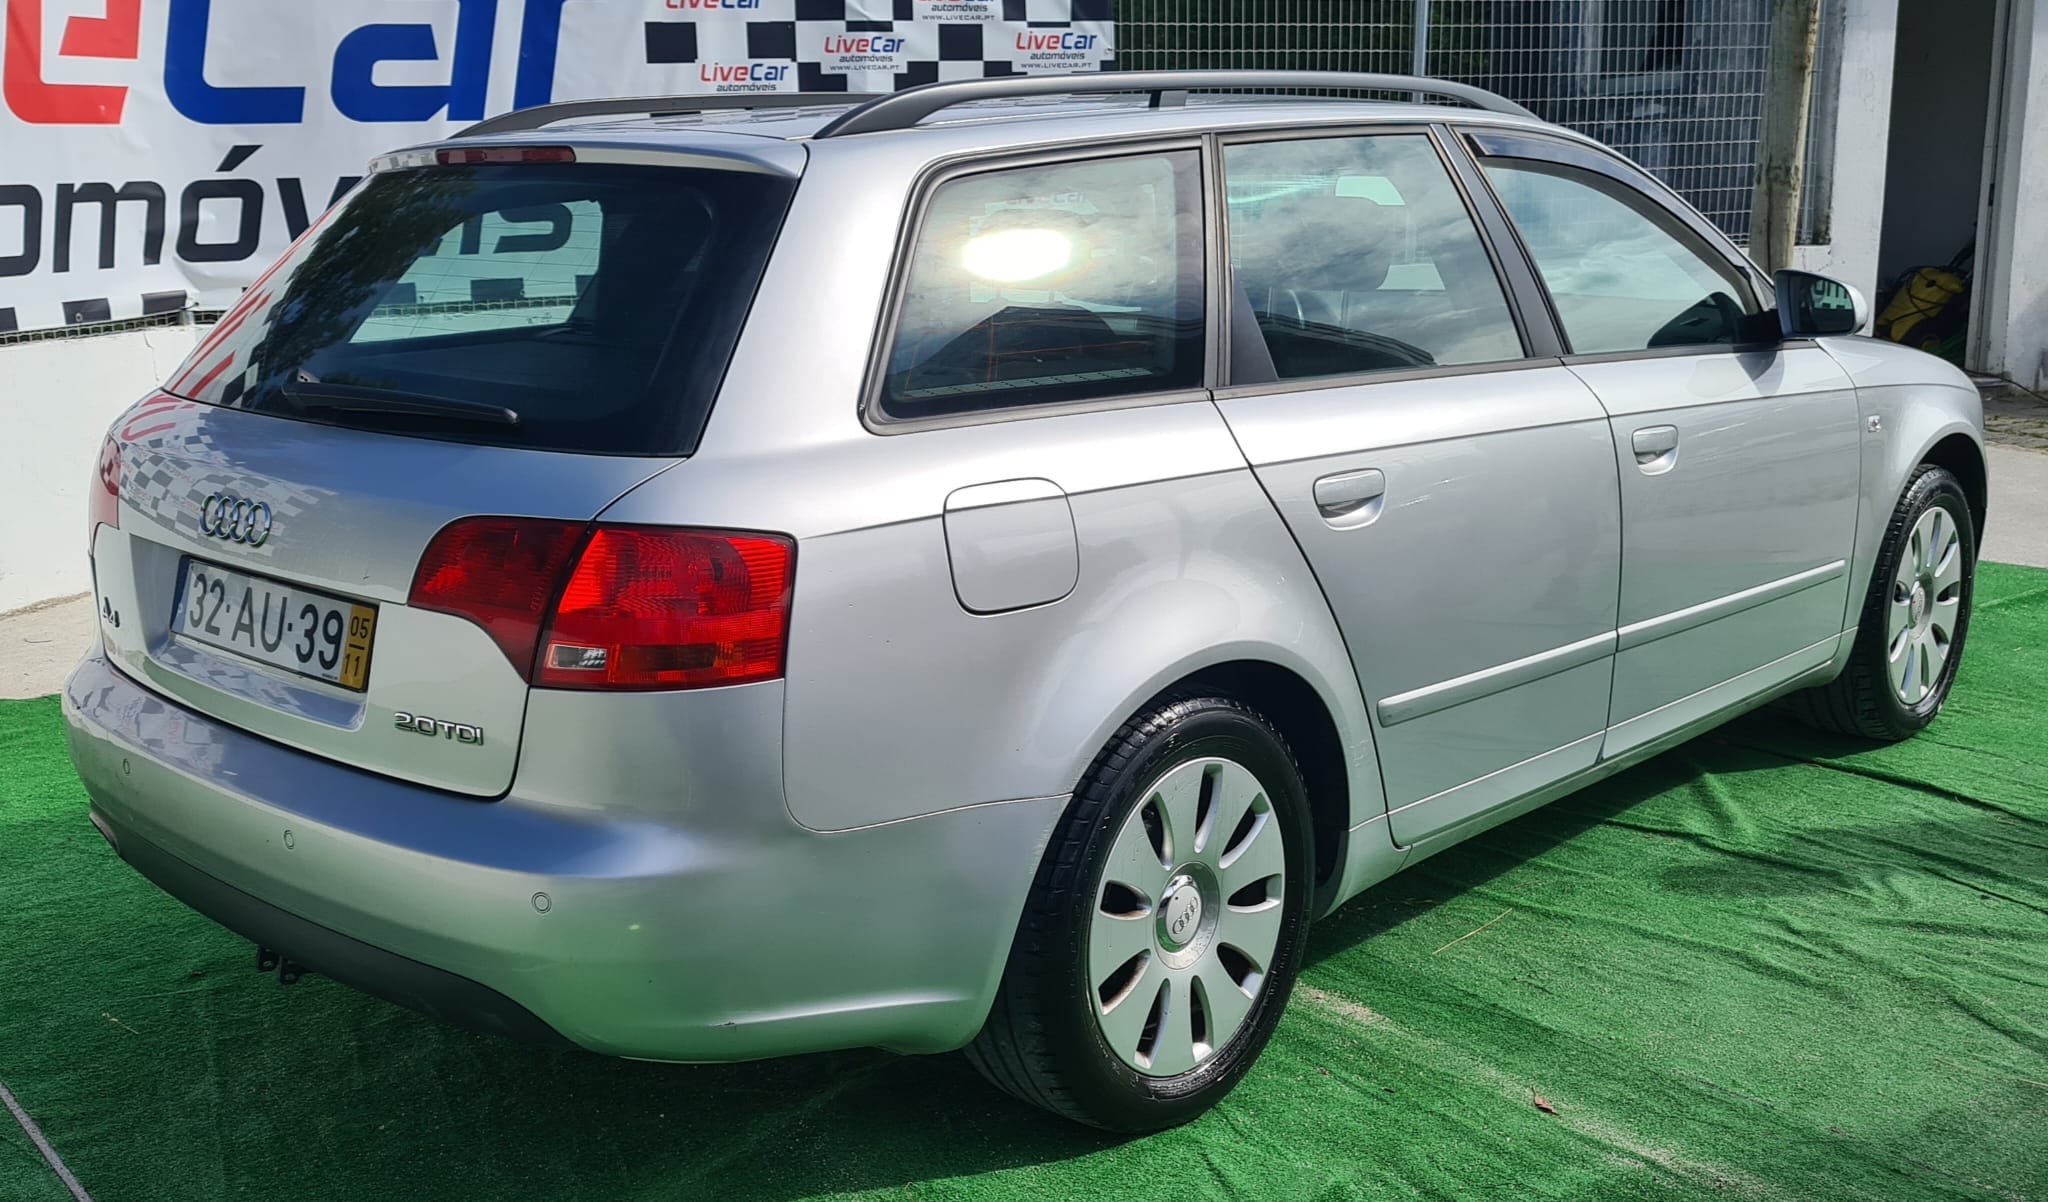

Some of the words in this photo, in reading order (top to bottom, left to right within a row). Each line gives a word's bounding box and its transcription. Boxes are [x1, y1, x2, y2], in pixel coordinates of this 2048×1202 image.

[931, 3, 988, 12] automóveis
[824, 35, 905, 53] LiveCar
[1016, 31, 1097, 50] LiveCar
[839, 55, 893, 63] automóveis
[1030, 51, 1085, 60] automóveis
[700, 62, 789, 82] LiveCar
[716, 82, 777, 92] automóveis
[350, 616, 371, 639] 05
[344, 654, 361, 677] 11
